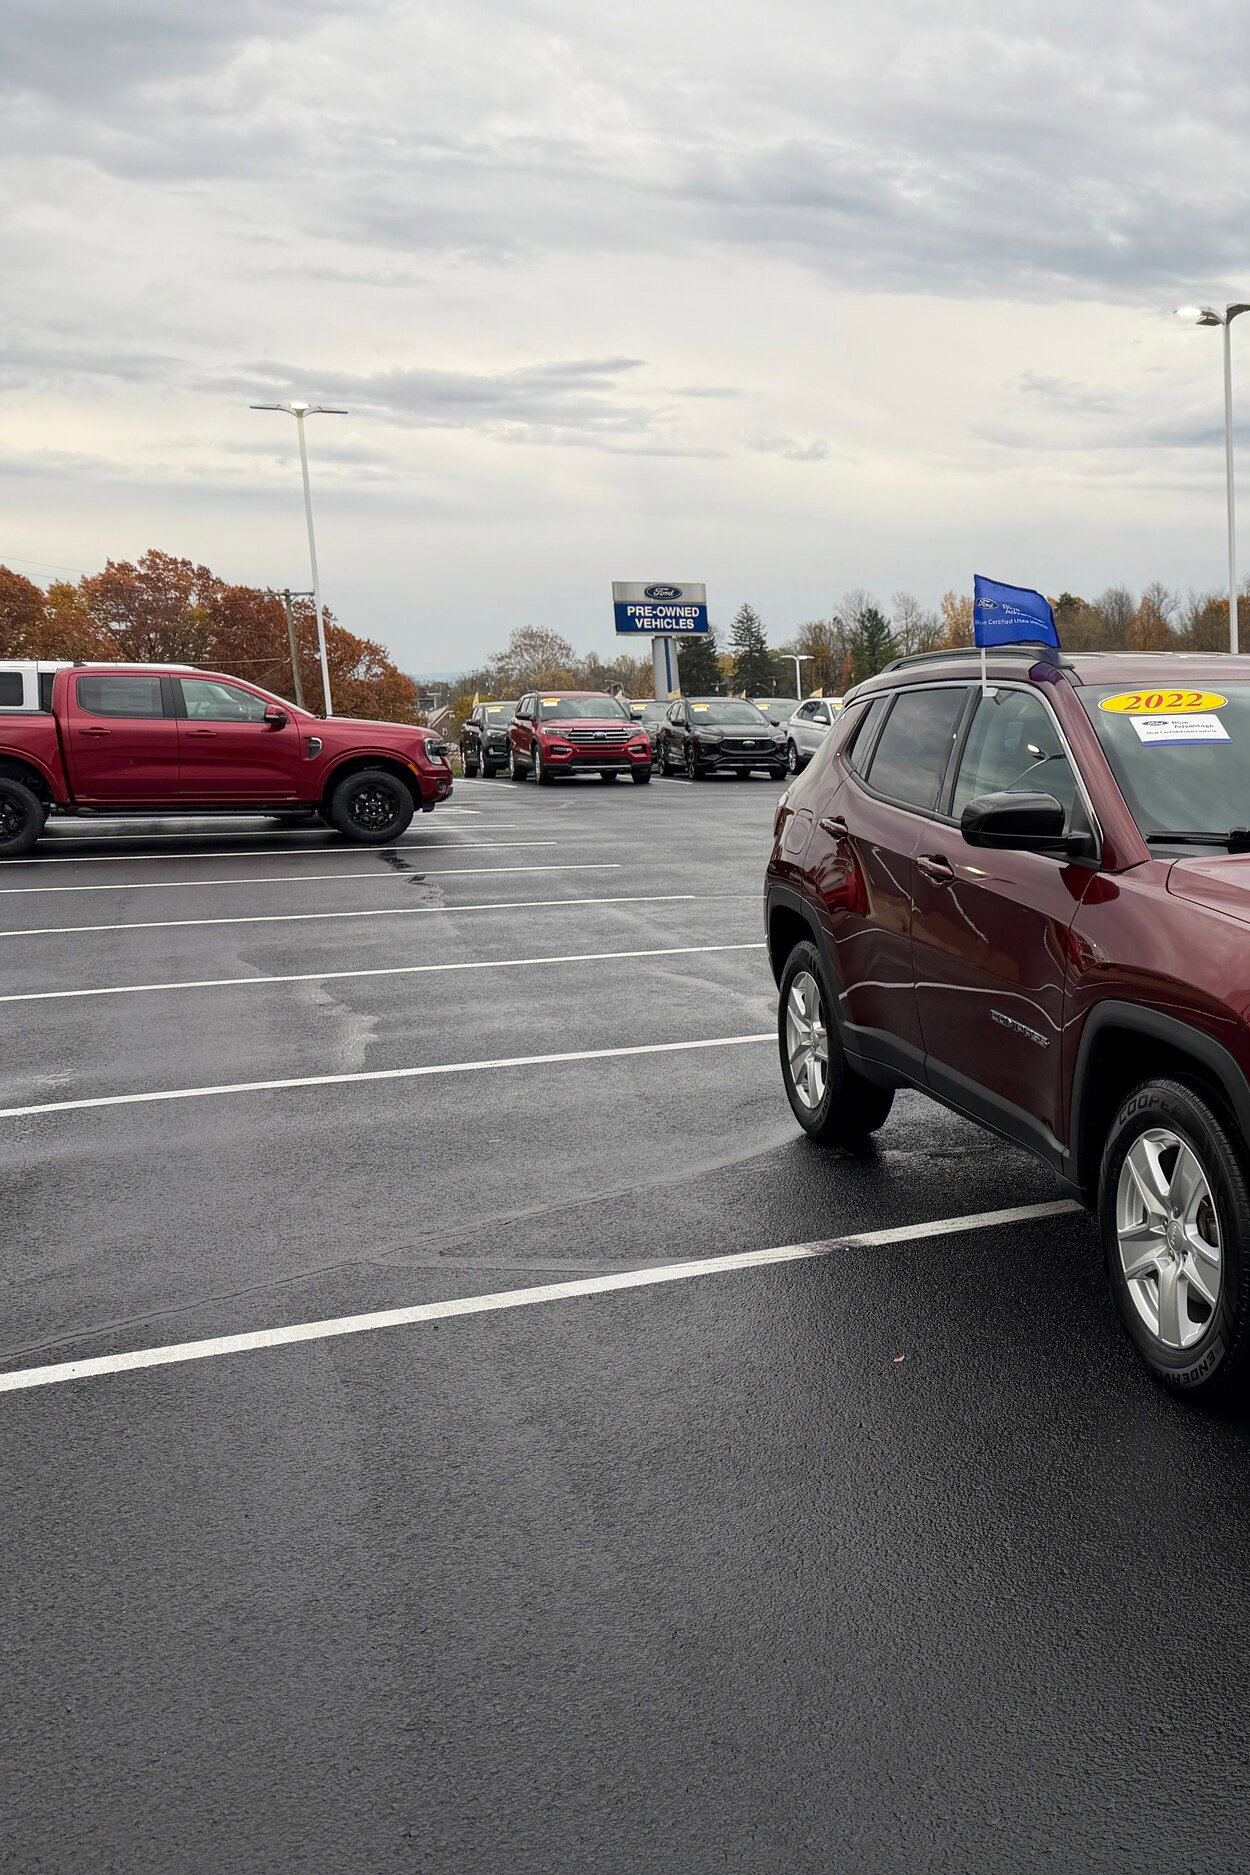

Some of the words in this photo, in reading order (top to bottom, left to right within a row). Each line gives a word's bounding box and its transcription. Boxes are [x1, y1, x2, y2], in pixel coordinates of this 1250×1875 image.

[653, 587, 676, 597] Ford
[978, 598, 994, 609] Ford
[627, 606, 700, 618] PRE-OWNED
[635, 618, 695, 630] VEHICLES
[1123, 693, 1203, 710] 2022
